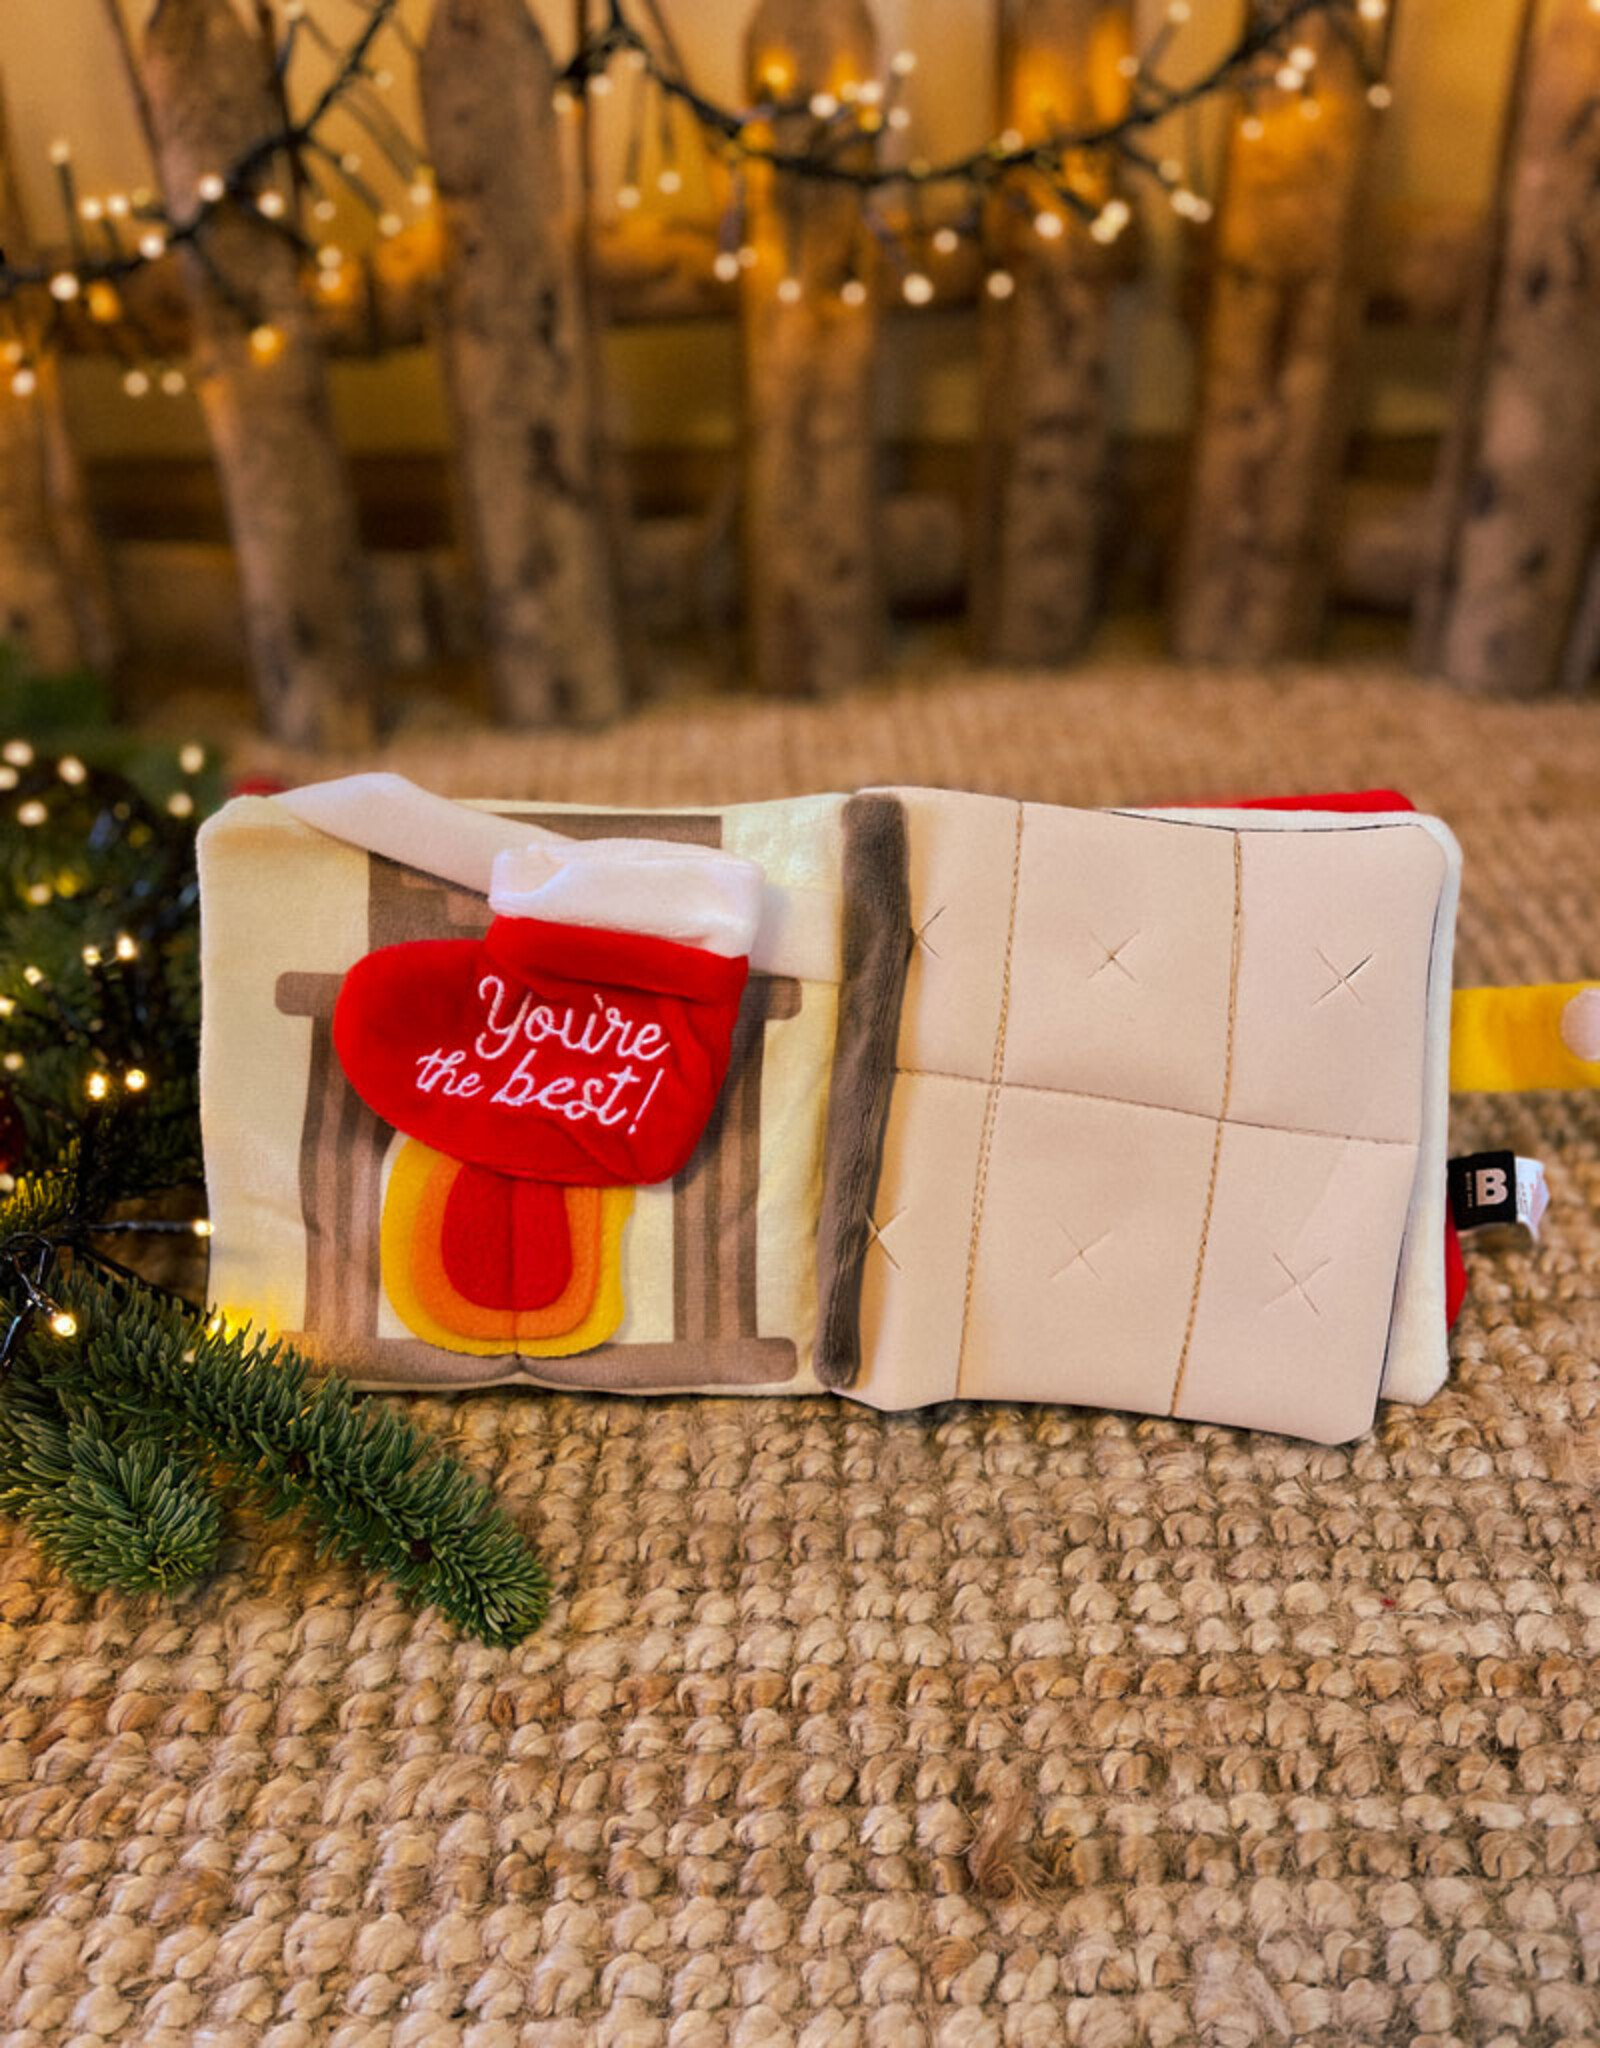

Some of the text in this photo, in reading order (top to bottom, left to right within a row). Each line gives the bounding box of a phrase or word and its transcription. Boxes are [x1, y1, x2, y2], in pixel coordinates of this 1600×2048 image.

[475, 975, 671, 1060] You're
[416, 1048, 664, 1134] the best!
[1475, 1167, 1508, 1206] B
